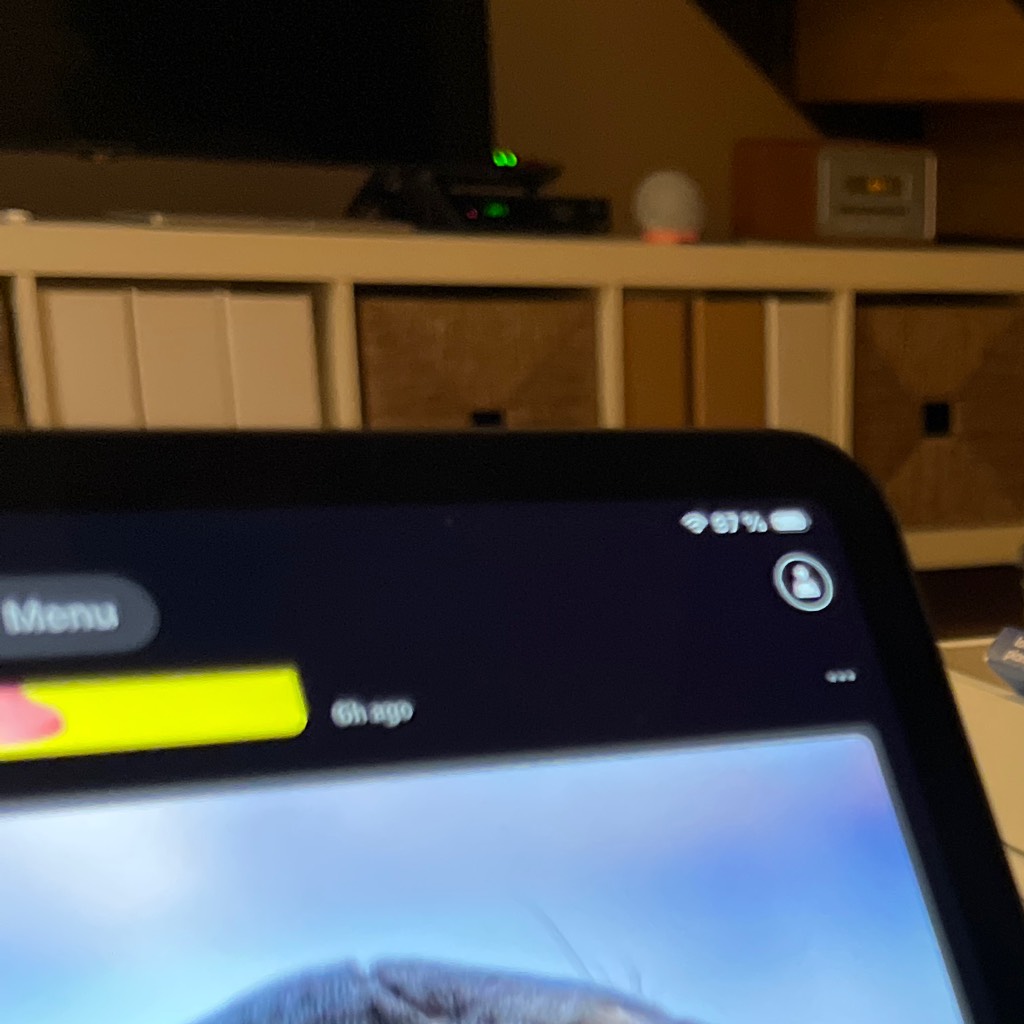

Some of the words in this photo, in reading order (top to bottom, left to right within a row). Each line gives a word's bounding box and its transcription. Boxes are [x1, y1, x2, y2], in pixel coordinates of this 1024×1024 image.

[2, 597, 119, 636] Menu
[331, 698, 369, 728] 6h
[370, 699, 414, 729] ago
